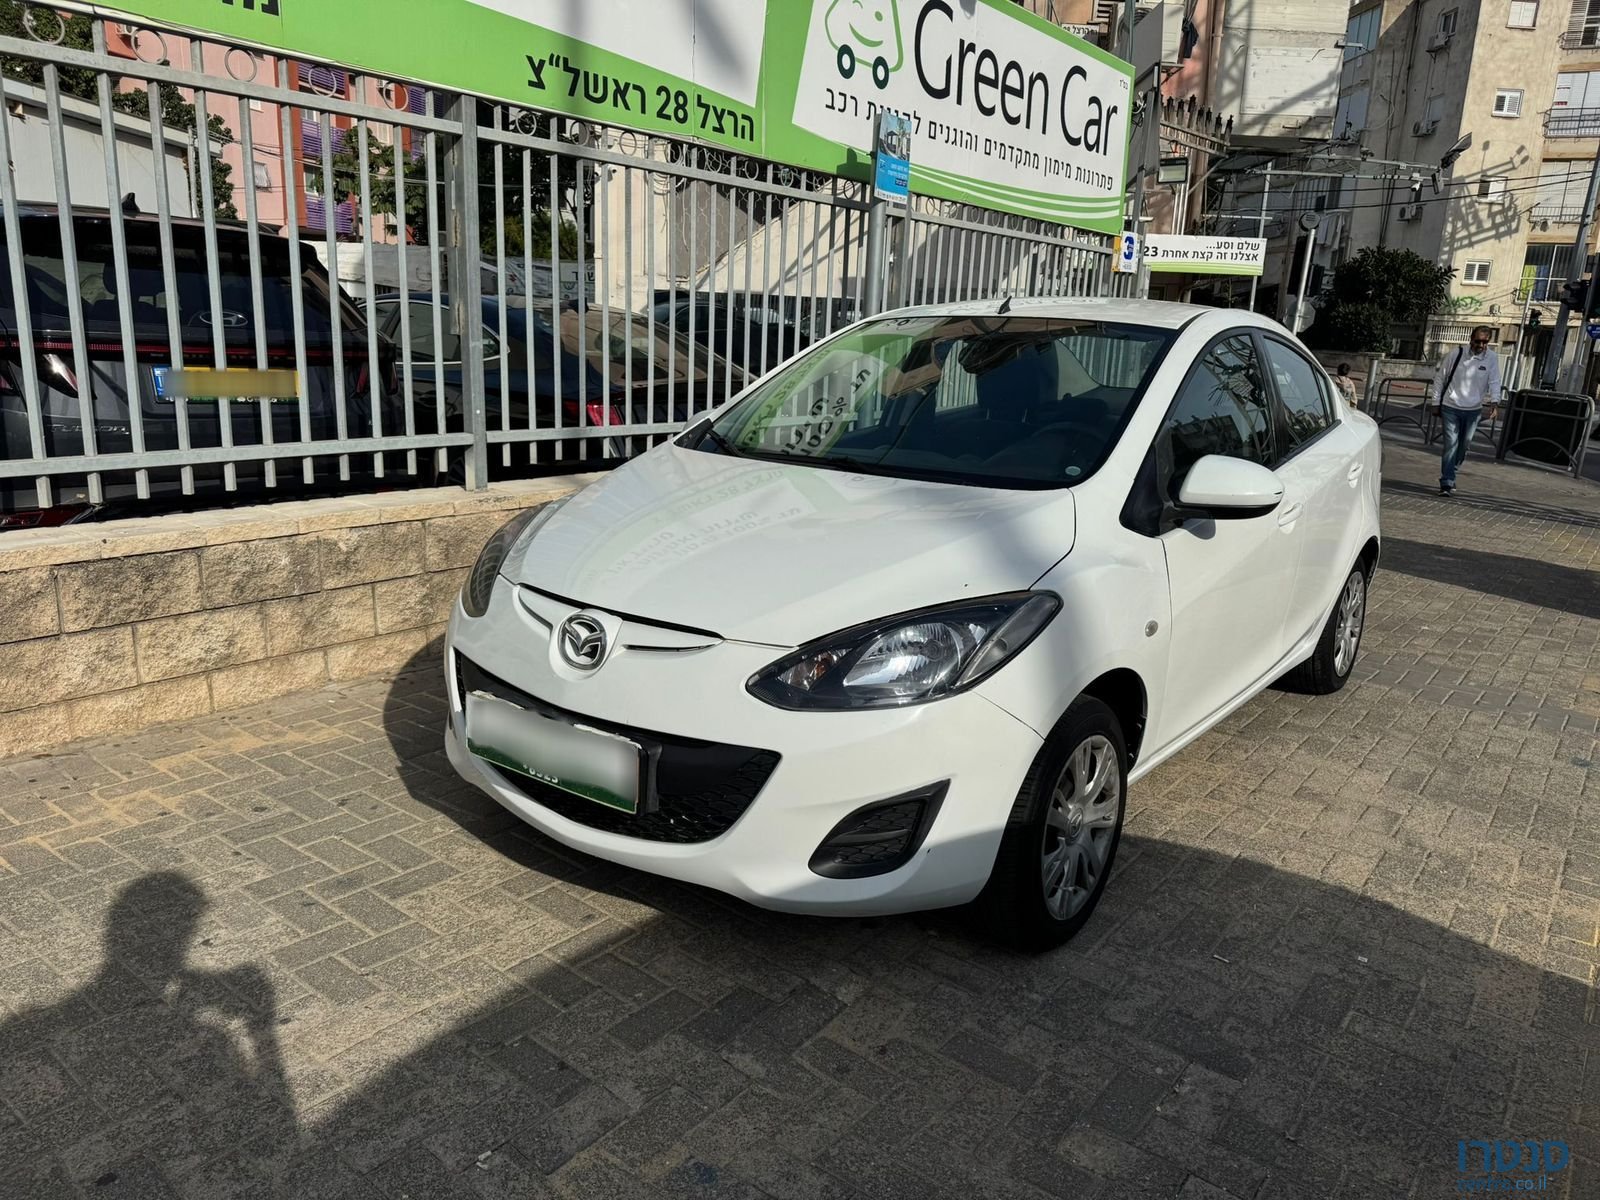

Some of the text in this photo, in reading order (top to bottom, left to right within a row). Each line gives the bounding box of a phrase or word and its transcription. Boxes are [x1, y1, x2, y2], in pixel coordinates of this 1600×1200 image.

[914, 0, 1118, 156] Green Car
[655, 84, 689, 125] 28
[696, 93, 754, 142] הרצל
[825, 87, 1114, 191] פתרונות מימון מתקדמים והוגנים רכב
[1161, 249, 1259, 262] אצלנו זה קצת אחרת
[1237, 240, 1260, 250] שלם
